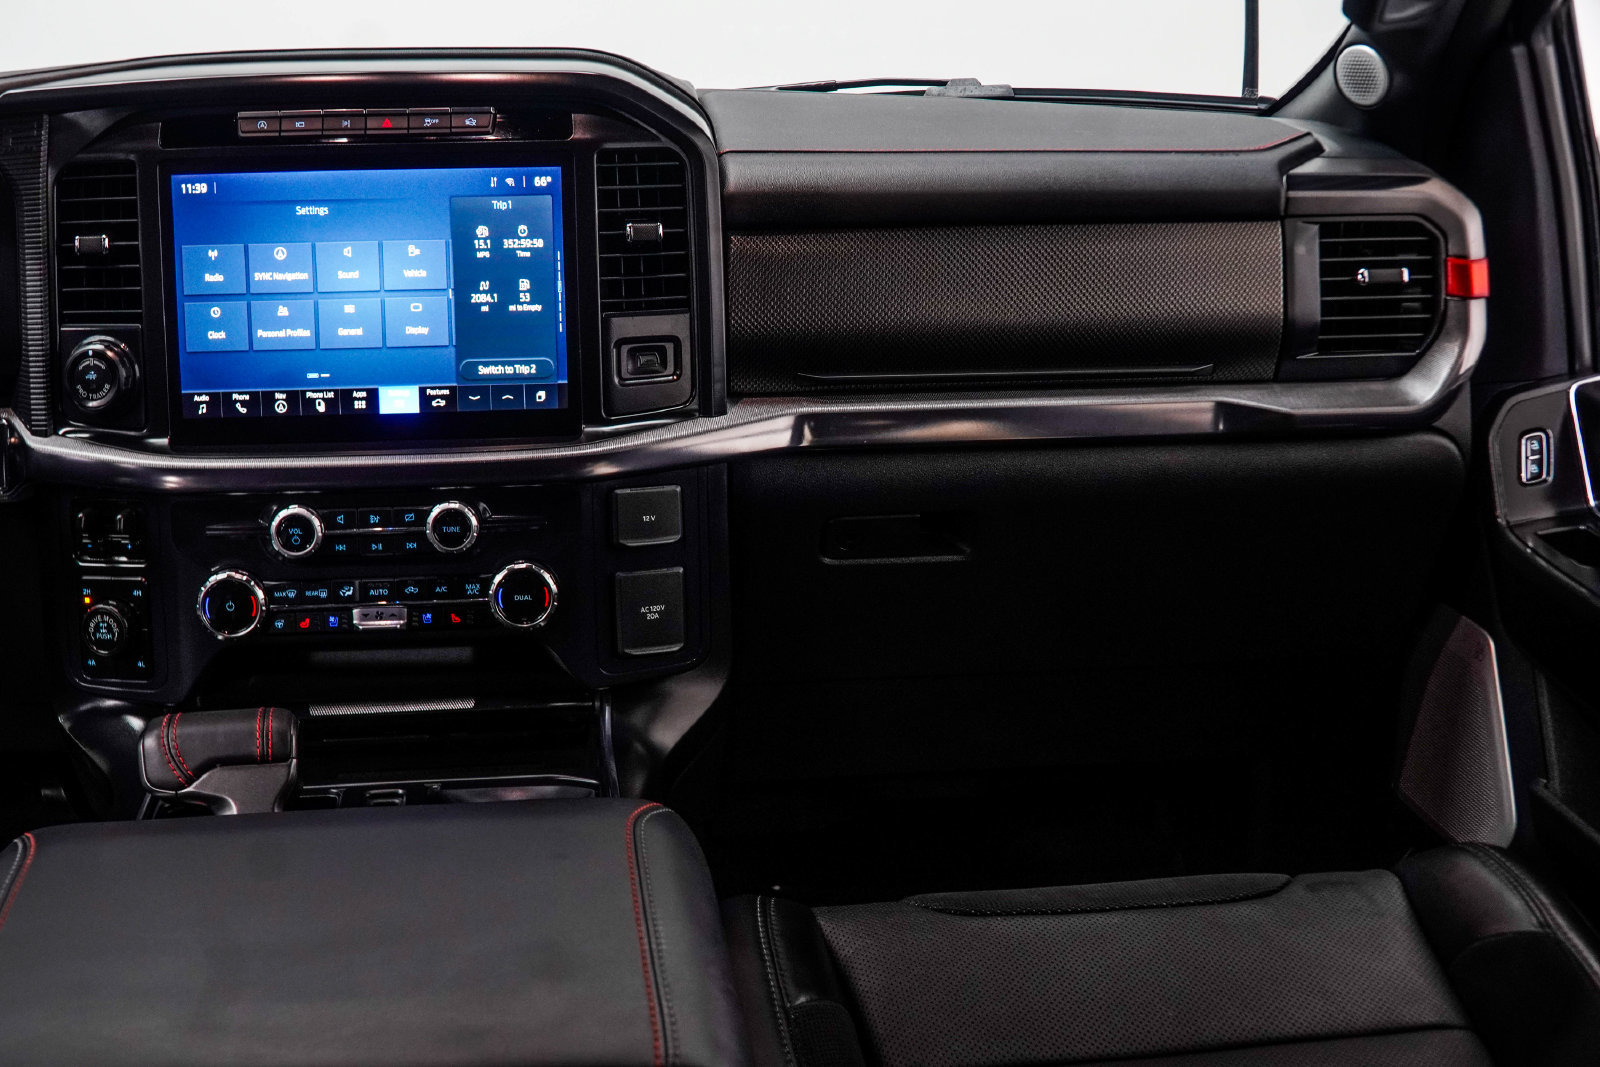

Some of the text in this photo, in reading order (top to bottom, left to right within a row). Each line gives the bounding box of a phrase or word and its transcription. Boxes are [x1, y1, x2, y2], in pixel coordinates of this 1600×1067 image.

[180, 182, 208, 194] 11:39
[492, 200, 506, 210] Trip
[296, 206, 328, 216] Settings
[474, 240, 491, 249] 15.1
[516, 250, 531, 258] Time
[205, 273, 224, 282] Radio
[254, 272, 308, 282] SYNC Navigation
[338, 270, 359, 279] Sound
[403, 269, 427, 278] Vehicle
[471, 293, 497, 303] 2084.1
[519, 292, 530, 302] 53
[523, 304, 542, 312] Empty
[208, 330, 226, 339] Clock
[257, 328, 311, 338] Personal Profiles
[338, 327, 363, 336] General
[405, 326, 429, 335] Display
[478, 364, 536, 376] Switch to Trip 2
[76, 384, 110, 399] PRO TRAILER
[275, 392, 286, 400] Nav
[306, 391, 323, 399] Phone
[353, 390, 367, 398] Apps
[426, 388, 450, 396] Features
[193, 394, 209, 402] Audio
[232, 393, 250, 401] Phone
[133, 589, 142, 597] 4H
[435, 585, 448, 593] A/C
[650, 604, 665, 612] 120V
[88, 616, 120, 633] DRIVE MODE
[96, 632, 113, 640] PUSH
[87, 659, 96, 667] 4A
[137, 660, 146, 668] 4L
